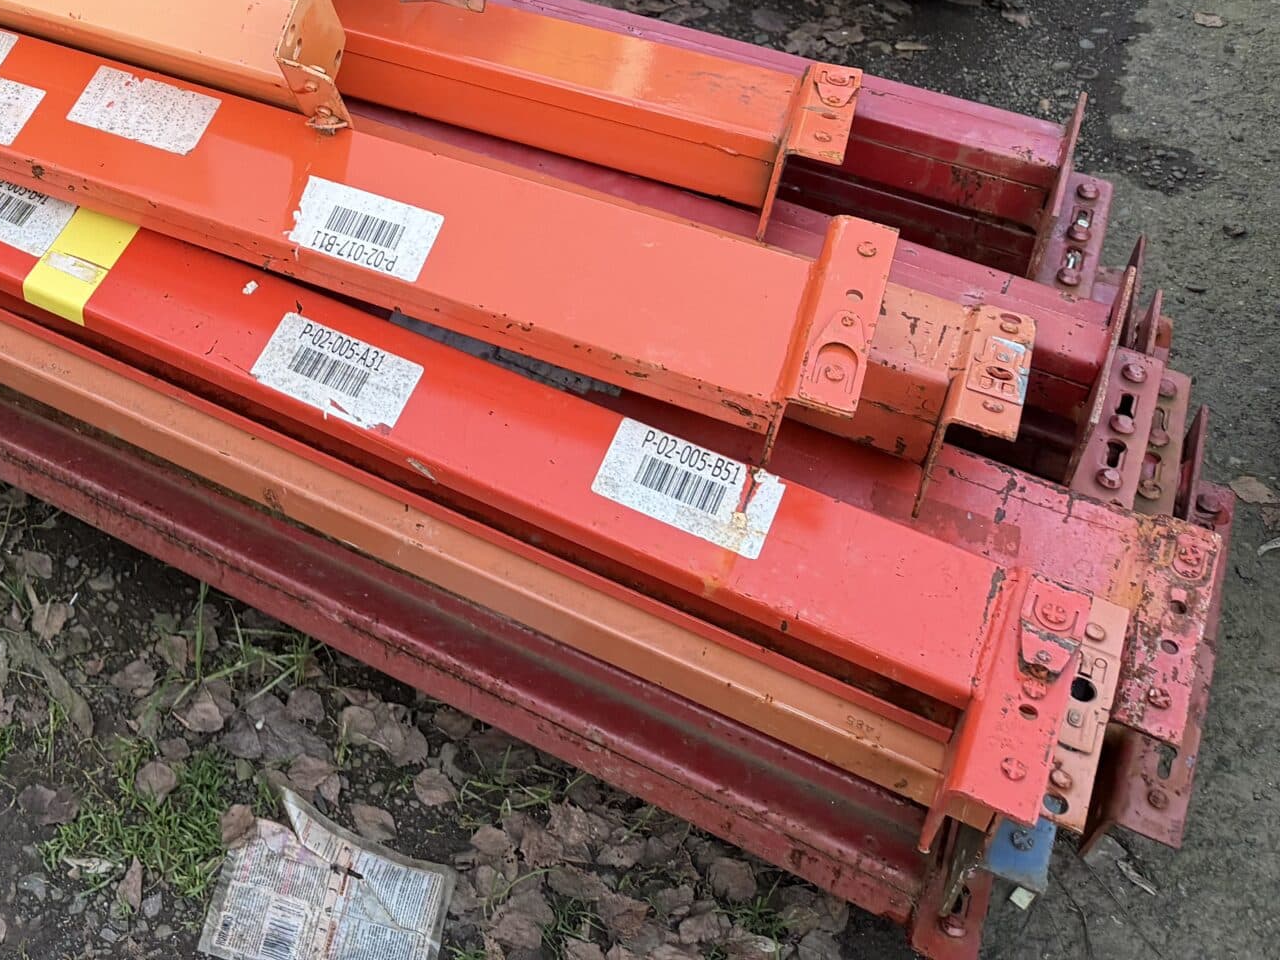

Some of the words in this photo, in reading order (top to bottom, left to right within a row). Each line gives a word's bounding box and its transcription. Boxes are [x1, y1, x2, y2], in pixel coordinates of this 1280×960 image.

[312, 230, 398, 272] P-02-017-B11
[299, 323, 385, 372] P-02-005-A31
[641, 430, 741, 485] P-02-005-B51
